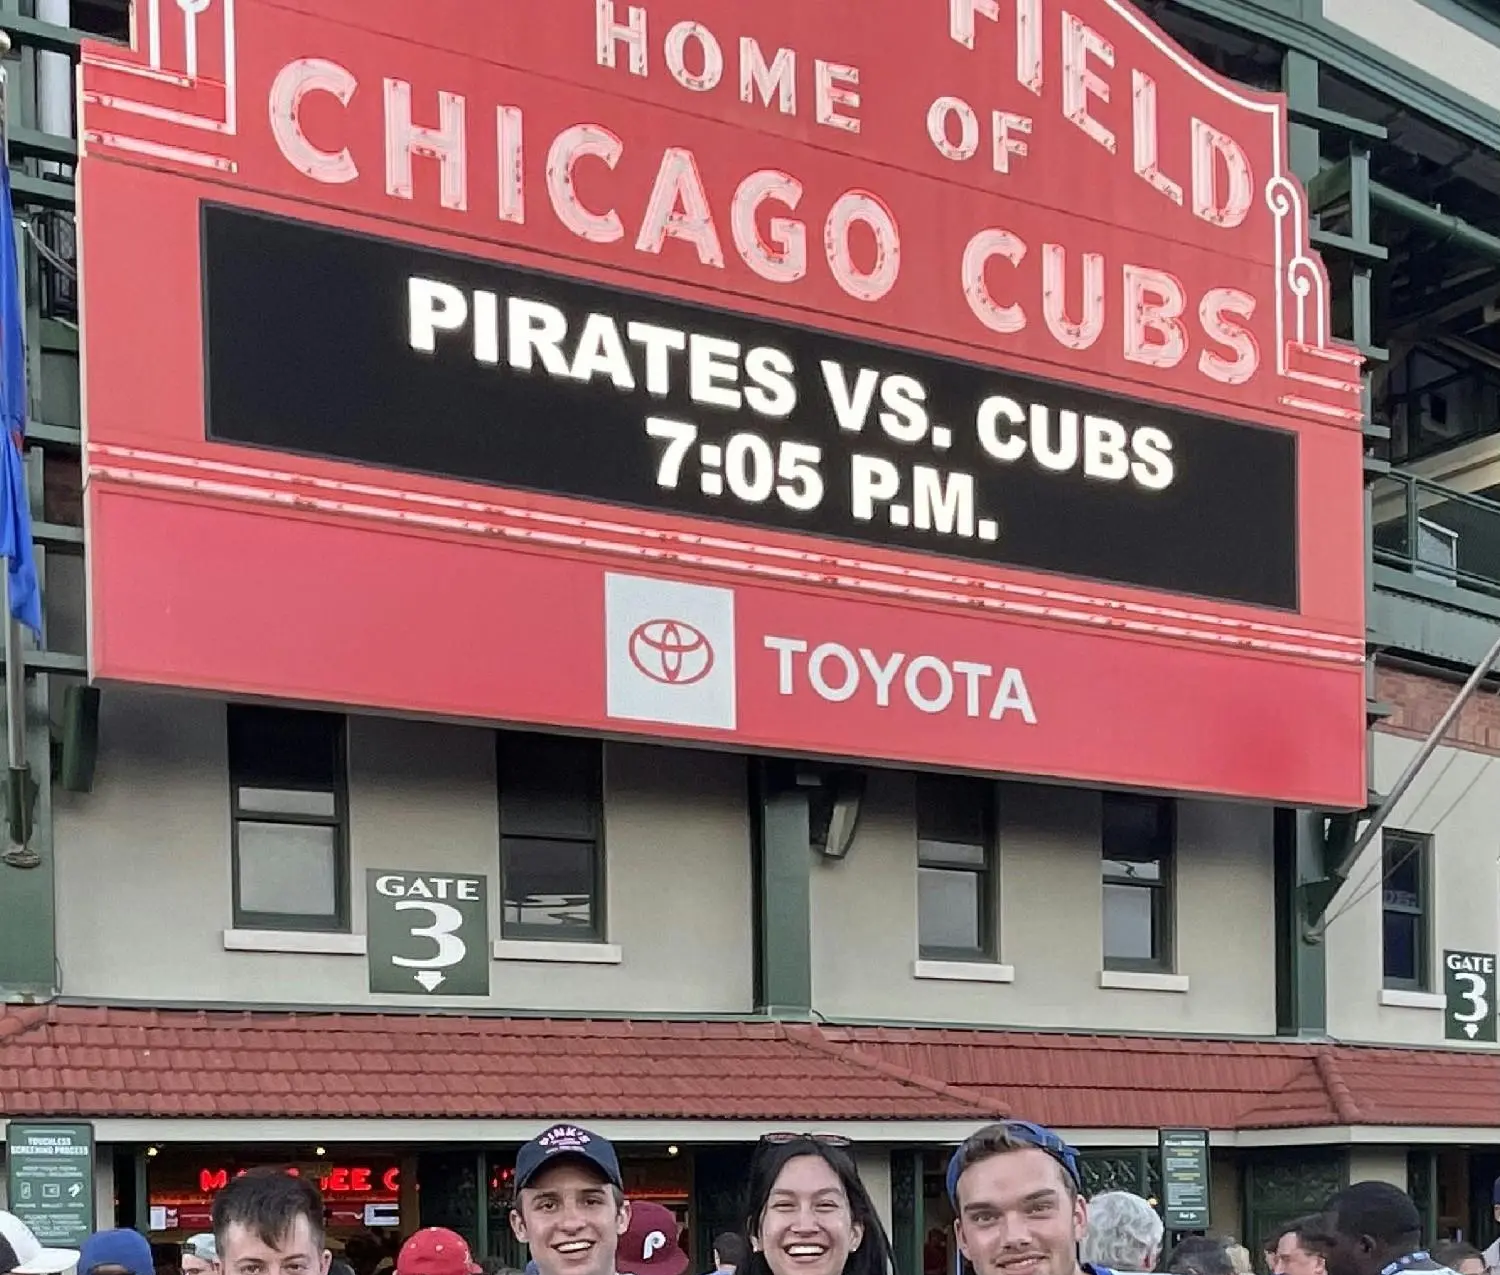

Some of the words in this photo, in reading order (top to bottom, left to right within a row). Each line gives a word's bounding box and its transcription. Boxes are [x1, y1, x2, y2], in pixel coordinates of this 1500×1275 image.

[596, 0, 861, 133] HOME
[926, 96, 1033, 174] OF
[268, 58, 901, 301] CHICAGO
[961, 228, 1260, 384] CUBS
[408, 276, 796, 418] PIRATES
[820, 360, 952, 448] VS.
[976, 395, 1176, 491] CUBS
[645, 417, 823, 511] 7:05
[850, 454, 998, 541] P.M.
[764, 635, 1038, 725] TOYOTA
[375, 875, 480, 901] GATE
[391, 900, 466, 968] 3
[1446, 953, 1494, 974] GATE
[1453, 972, 1489, 1022] 3
